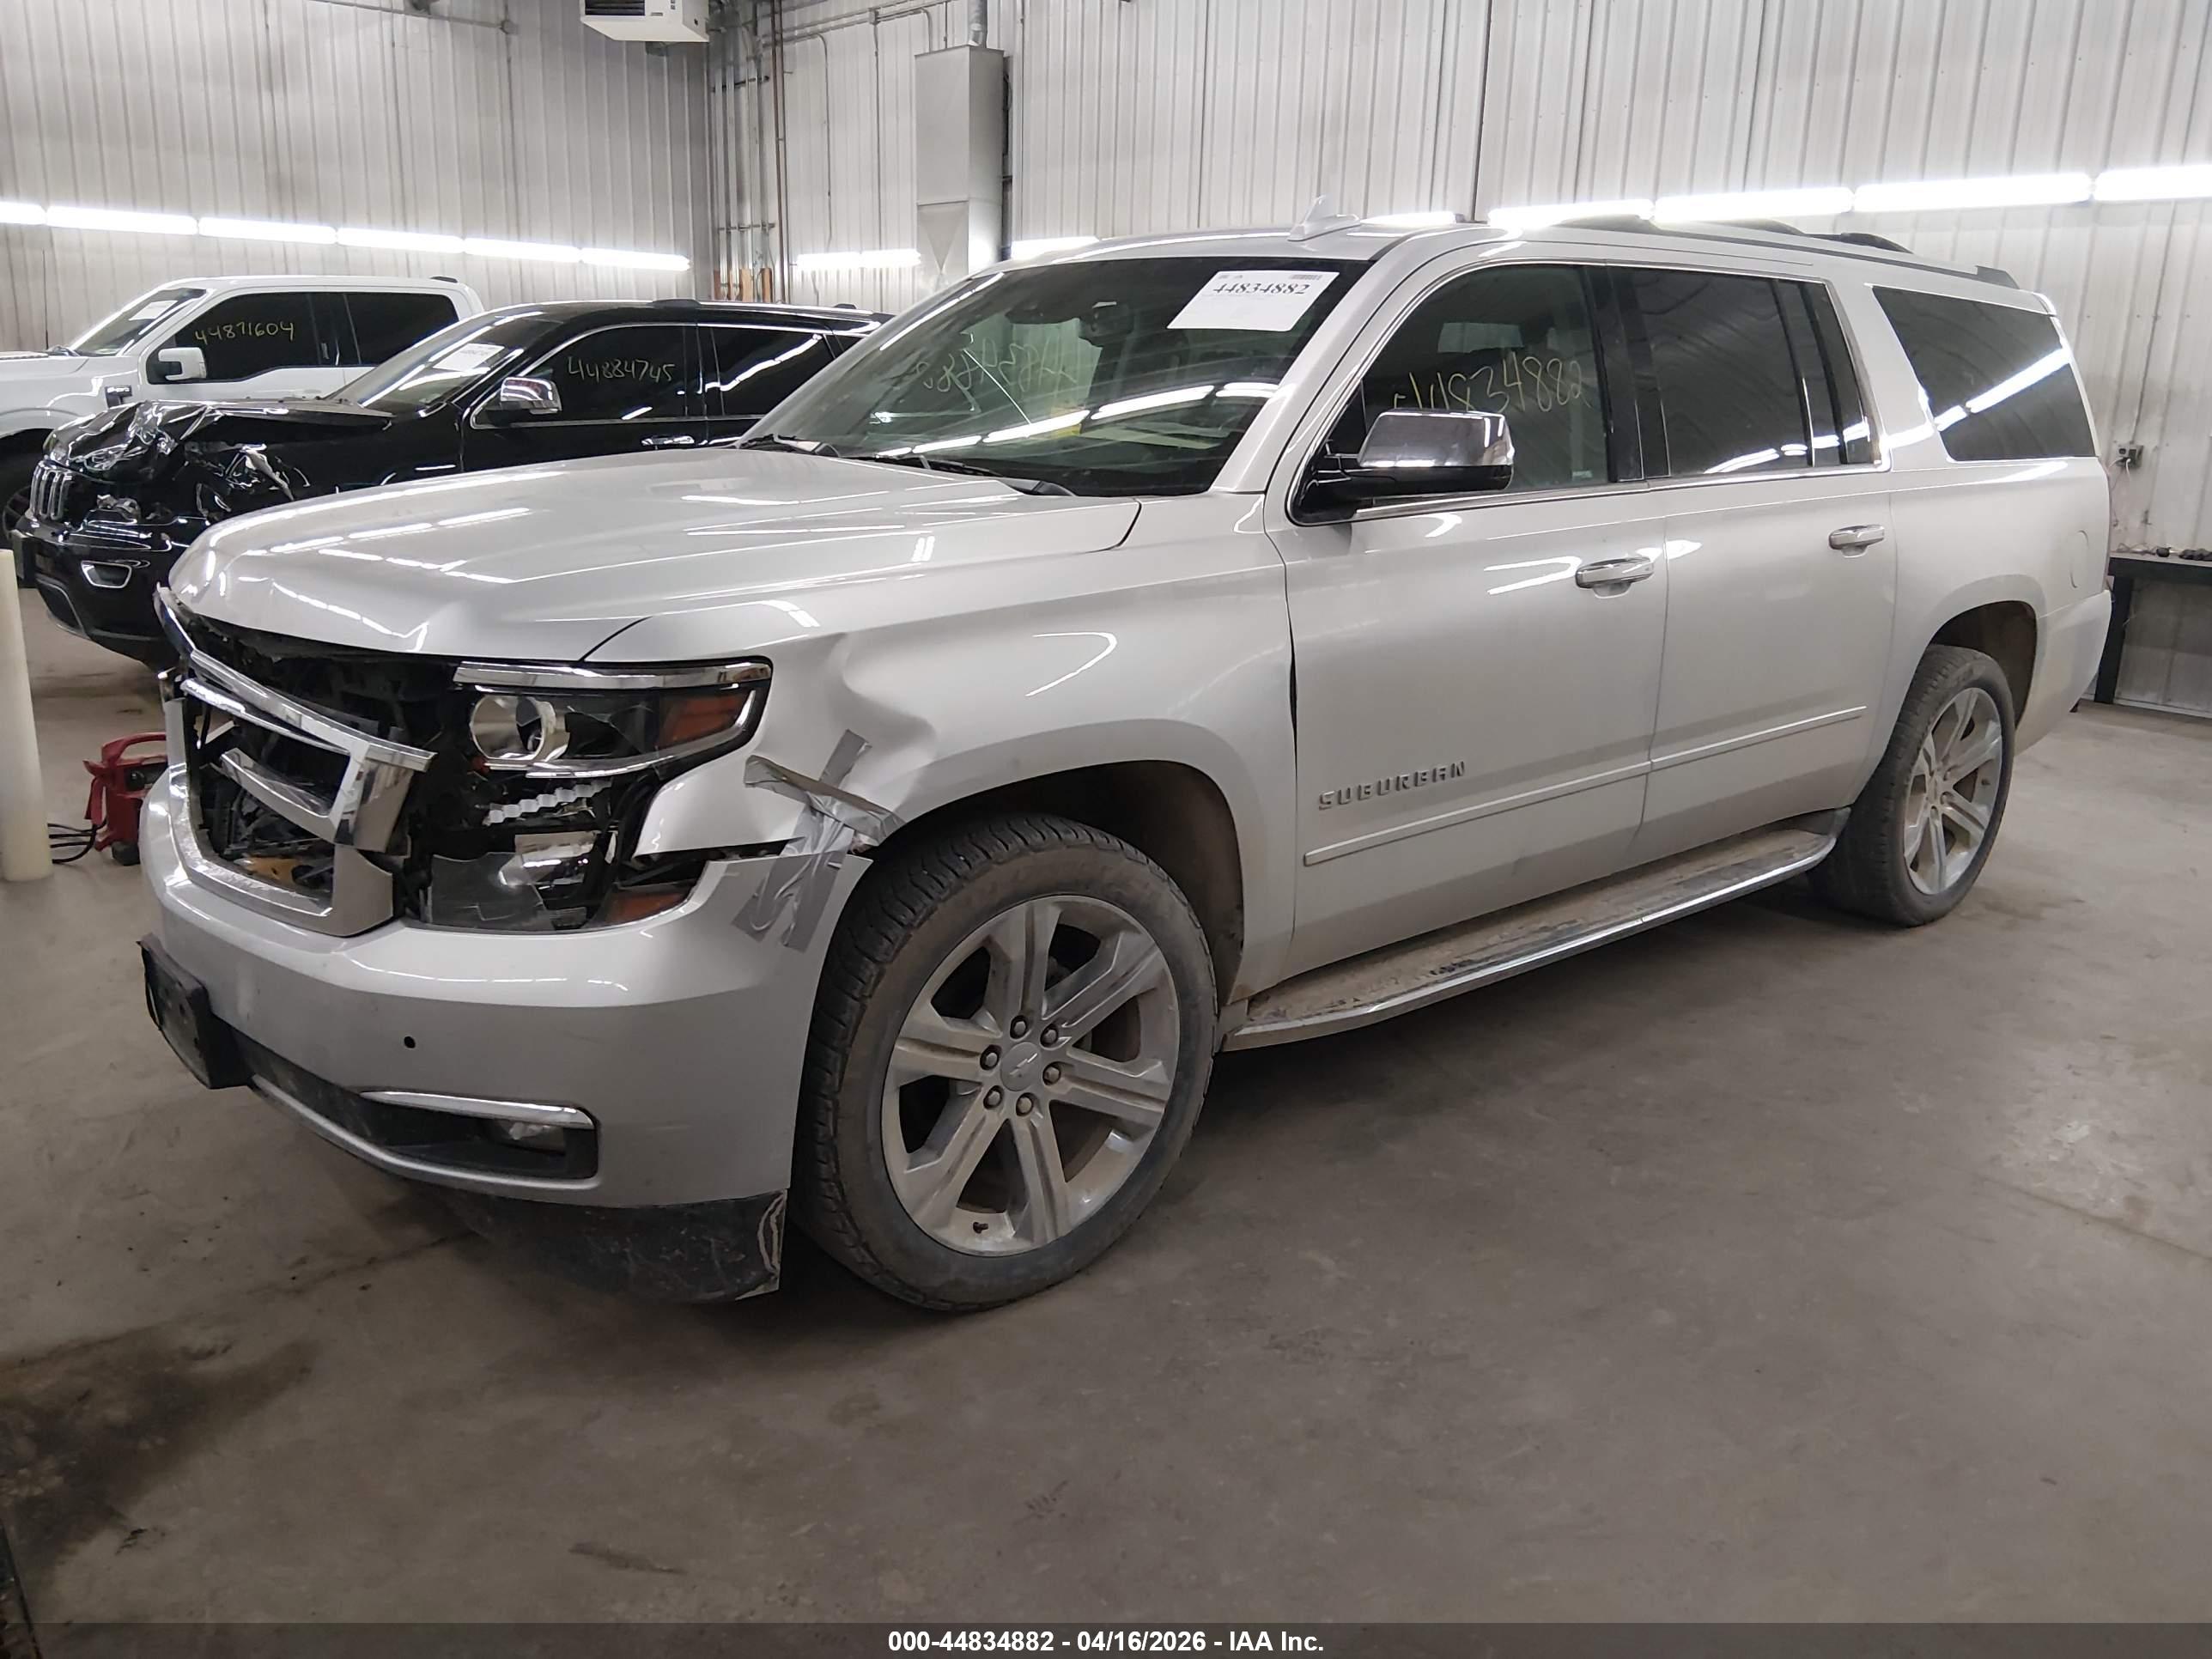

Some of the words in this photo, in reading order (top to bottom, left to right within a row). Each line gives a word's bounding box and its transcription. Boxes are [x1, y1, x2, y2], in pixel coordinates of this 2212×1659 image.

[1212, 282, 1311, 295] 44834882
[194, 320, 295, 345] 44871604
[568, 356, 676, 383] 44884745
[1318, 761, 1466, 811] SUBURBAN
